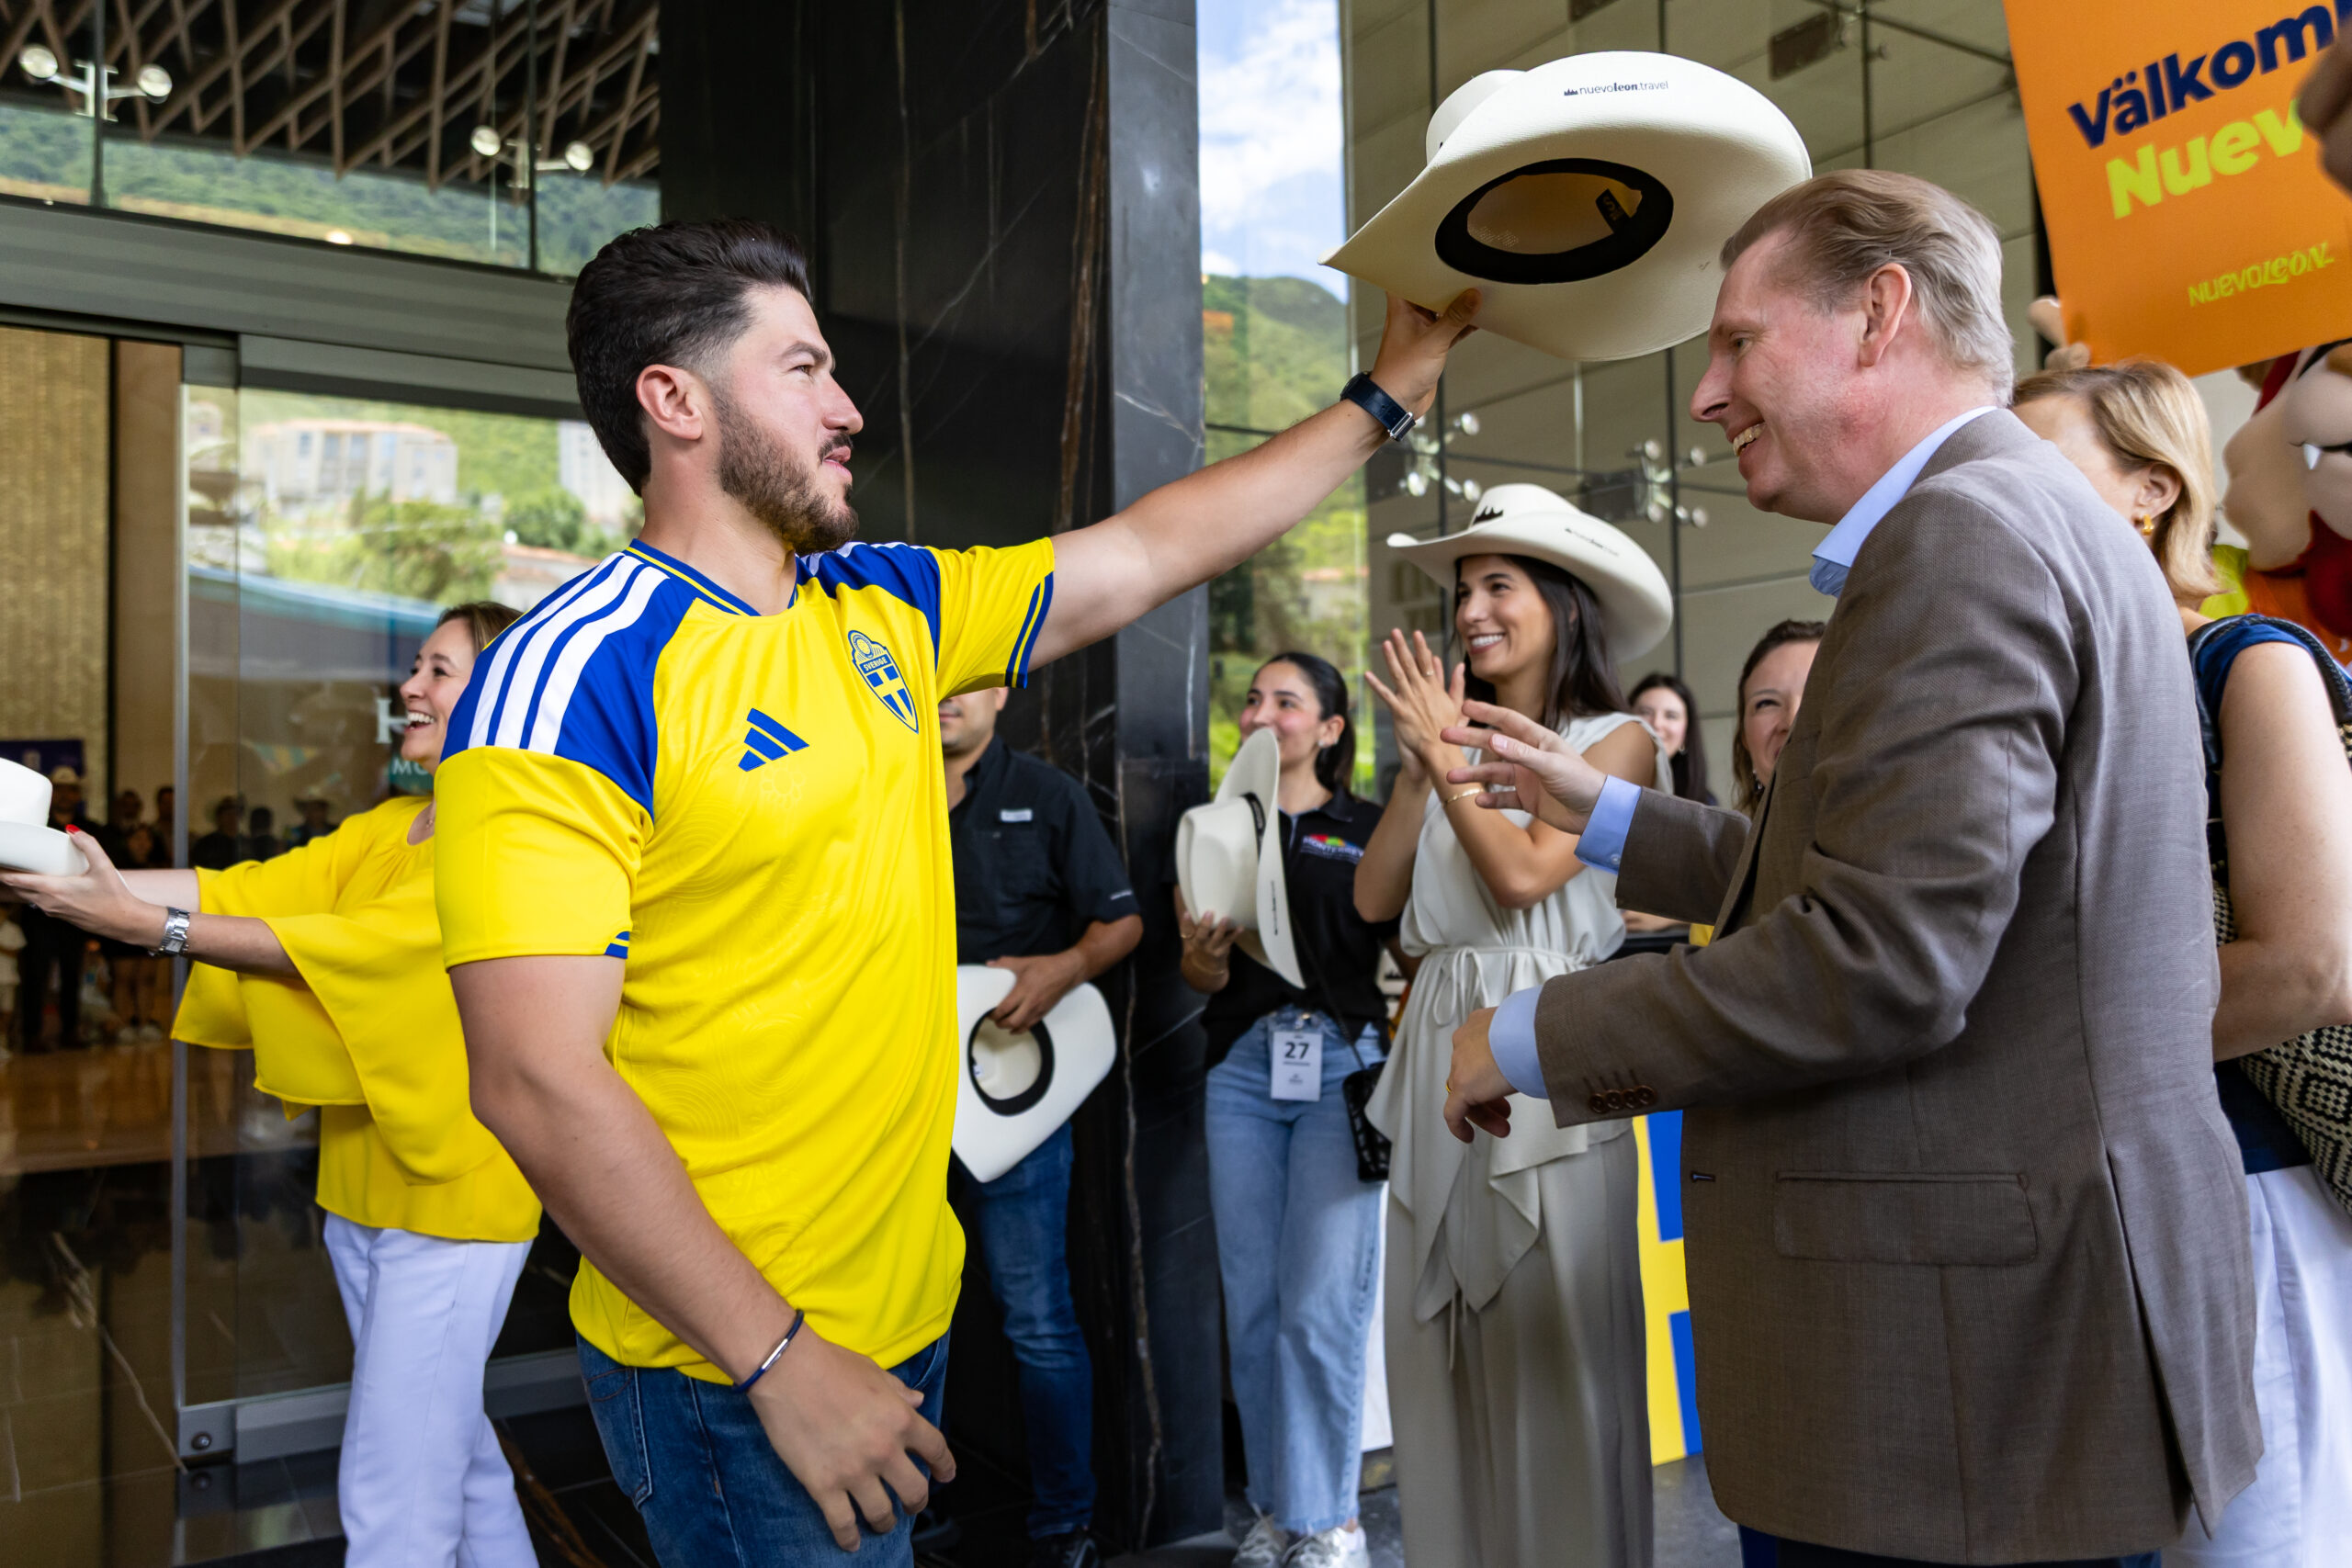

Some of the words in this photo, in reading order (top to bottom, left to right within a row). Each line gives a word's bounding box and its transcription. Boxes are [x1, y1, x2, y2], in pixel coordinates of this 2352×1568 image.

[2066, 0, 2352, 150] Välkom
[1579, 81, 1669, 96] nuevoleon.travel
[2106, 97, 2303, 220] Nuev
[863, 657, 888, 671] SVERIGE
[1284, 1042, 1310, 1059] 27
